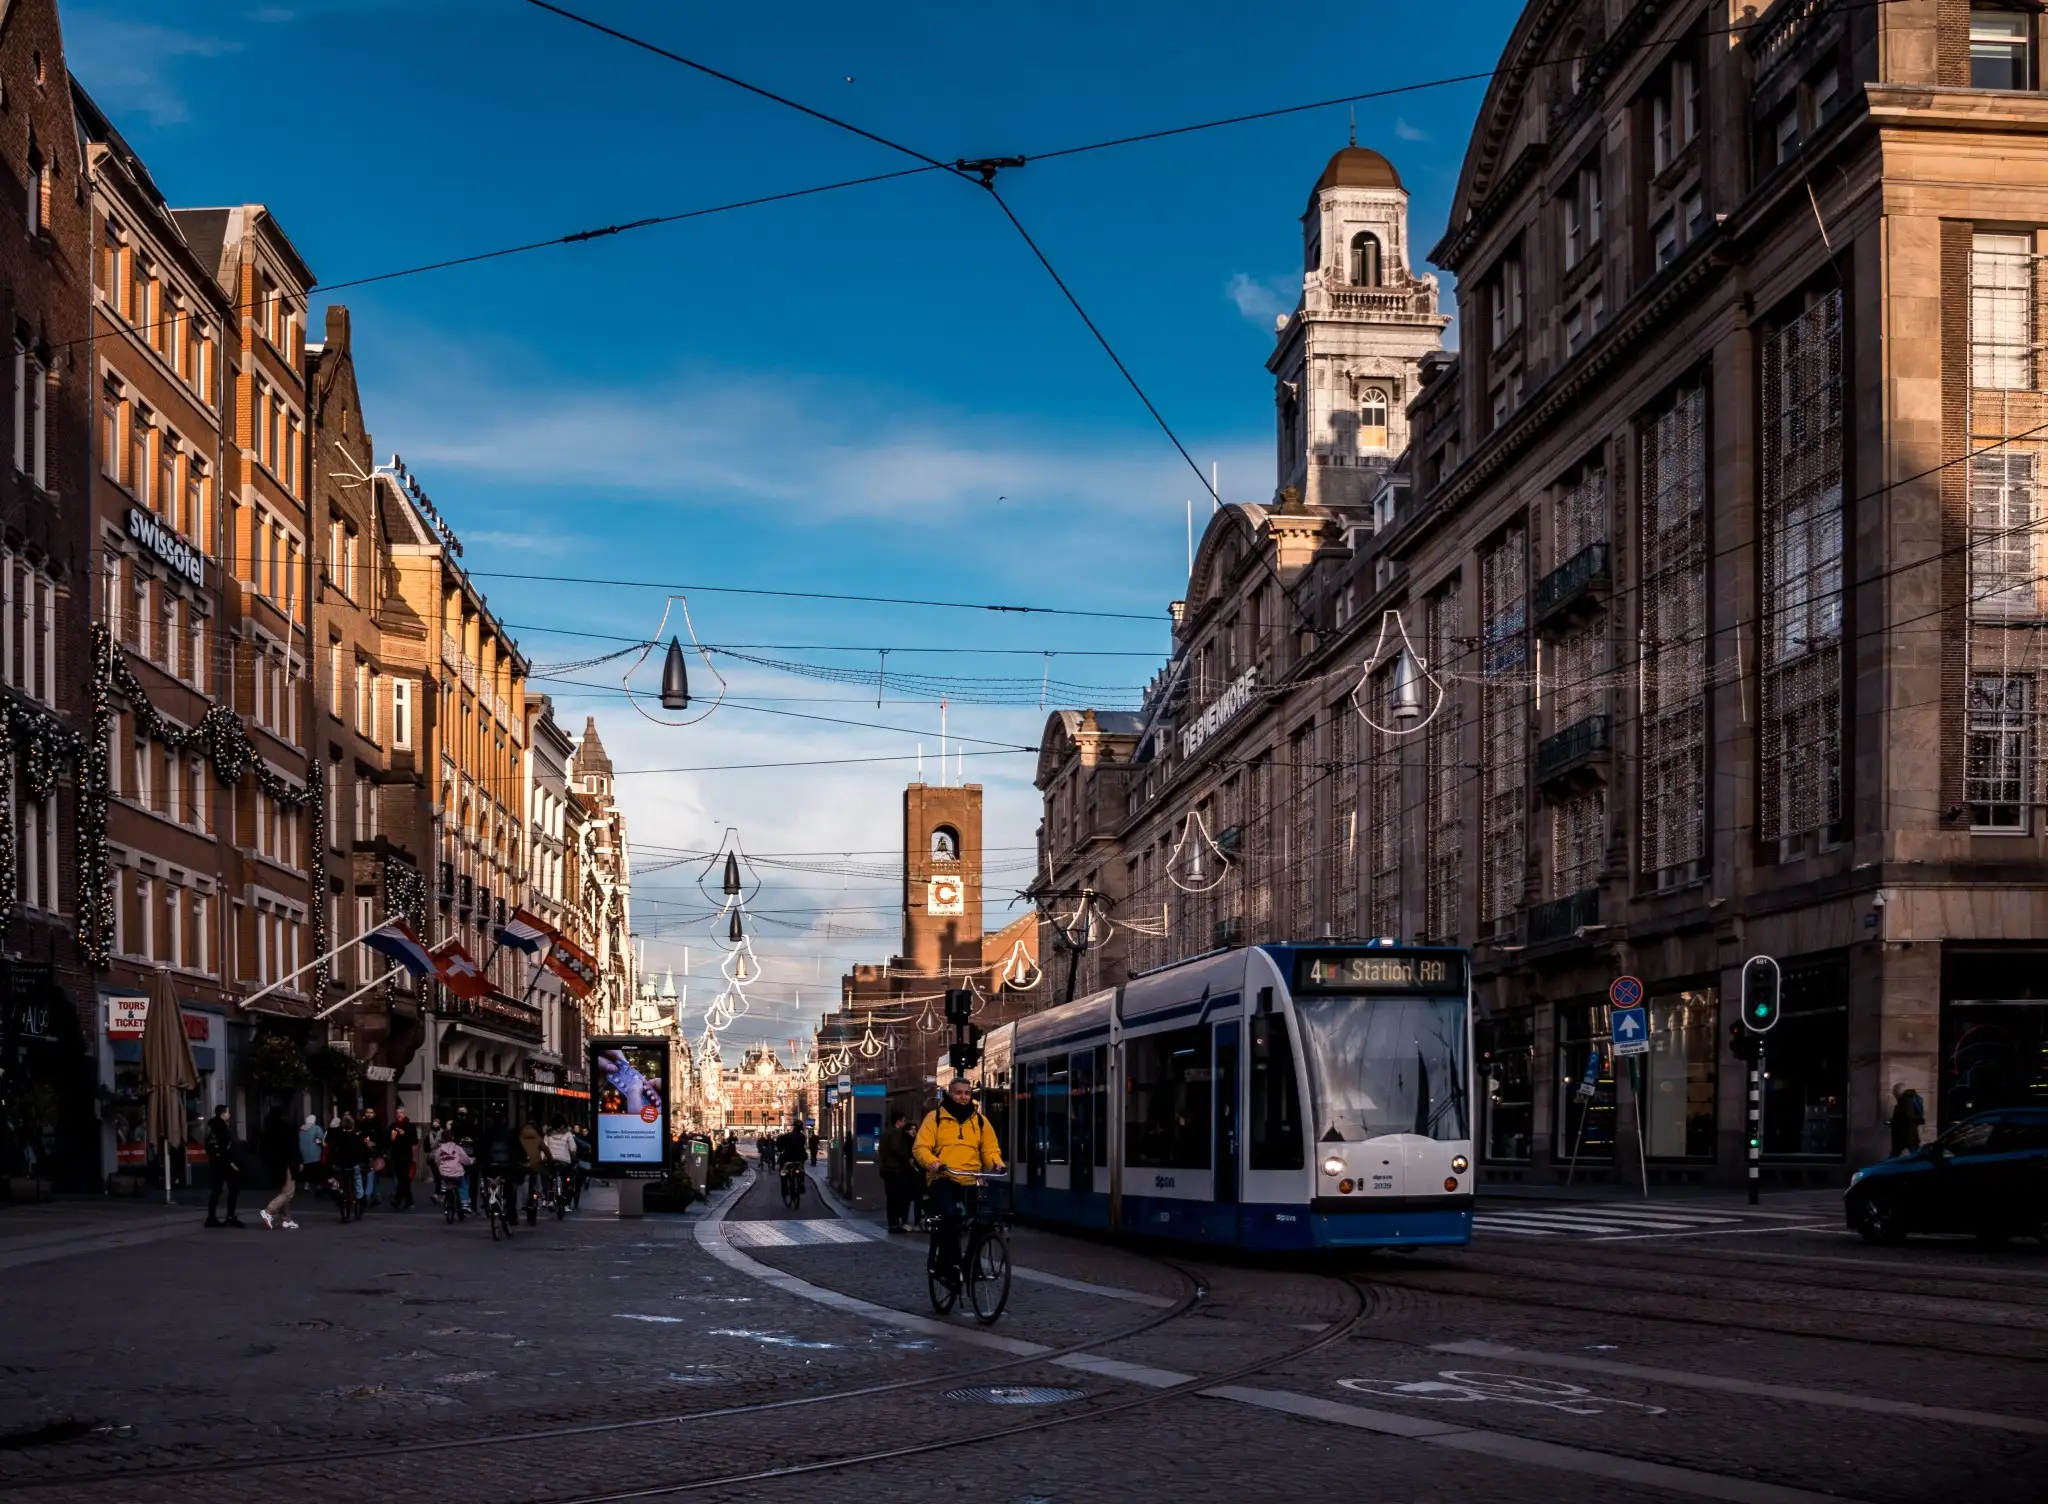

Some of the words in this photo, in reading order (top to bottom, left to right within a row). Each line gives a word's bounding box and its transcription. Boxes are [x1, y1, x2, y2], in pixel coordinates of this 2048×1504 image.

[1310, 958, 1322, 984] 4
[1352, 959, 1412, 981] Station
[1420, 960, 1446, 981] RAI
[118, 1001, 146, 1010] TOURS
[127, 1010, 134, 1018] &
[1373, 1182, 1392, 1190] 2039
